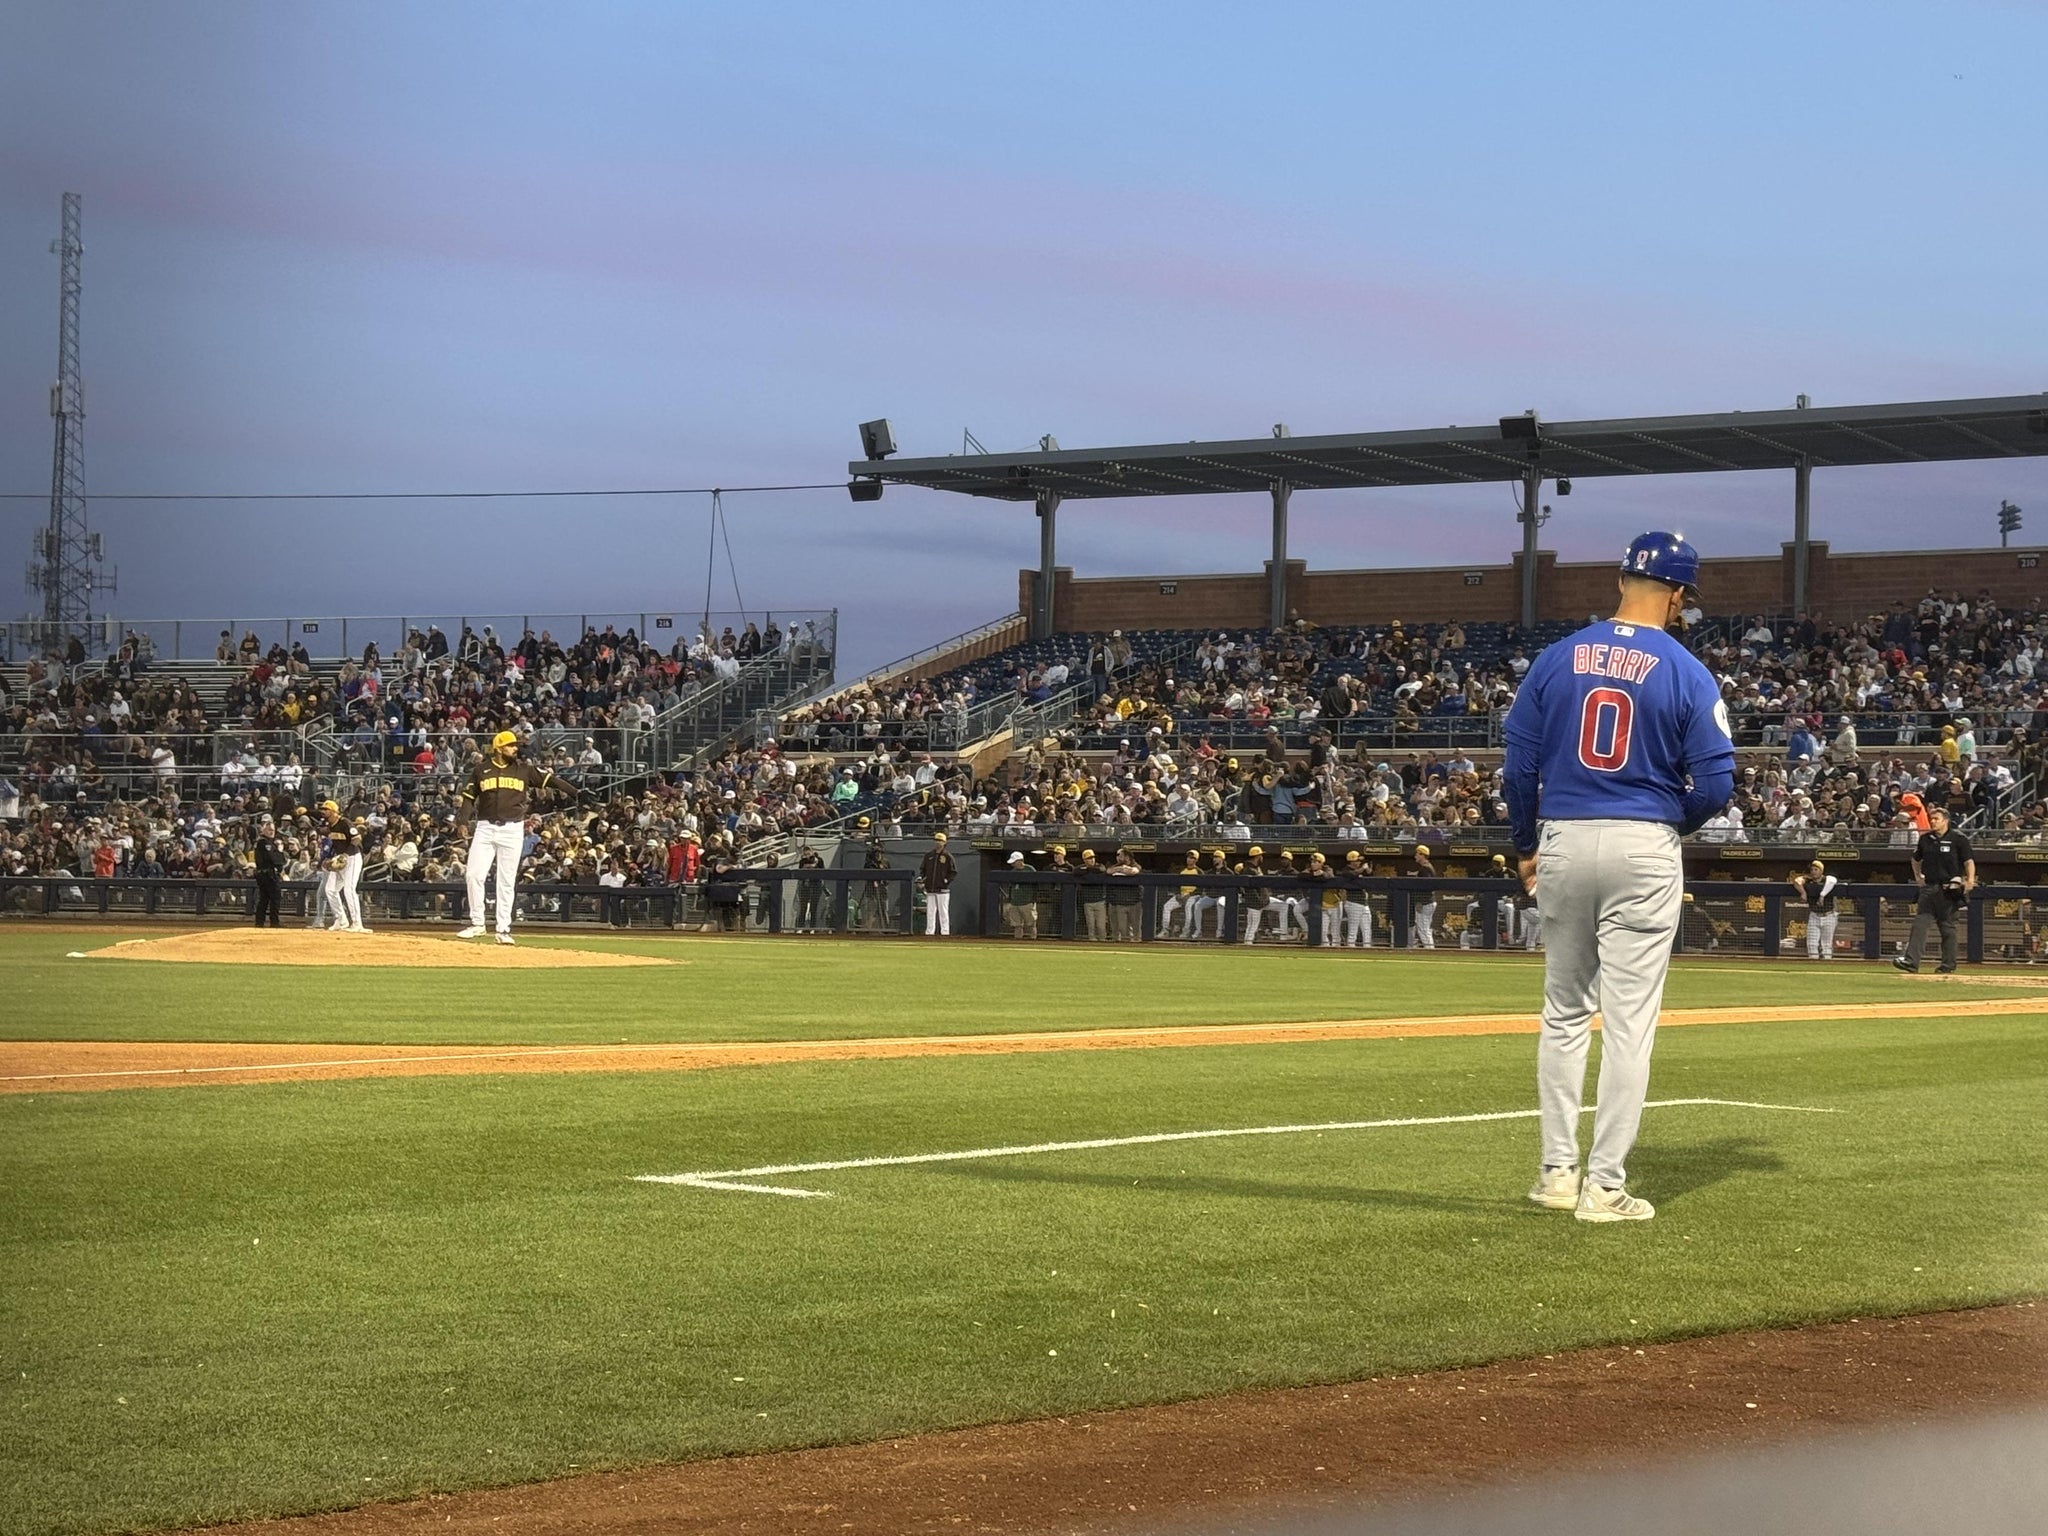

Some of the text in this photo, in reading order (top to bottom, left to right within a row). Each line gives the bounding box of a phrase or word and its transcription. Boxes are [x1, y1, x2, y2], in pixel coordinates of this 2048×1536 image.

[1573, 643, 1660, 684] BERRY
[1578, 687, 1634, 772] 0
[480, 776, 524, 792] SAN DIEGO
